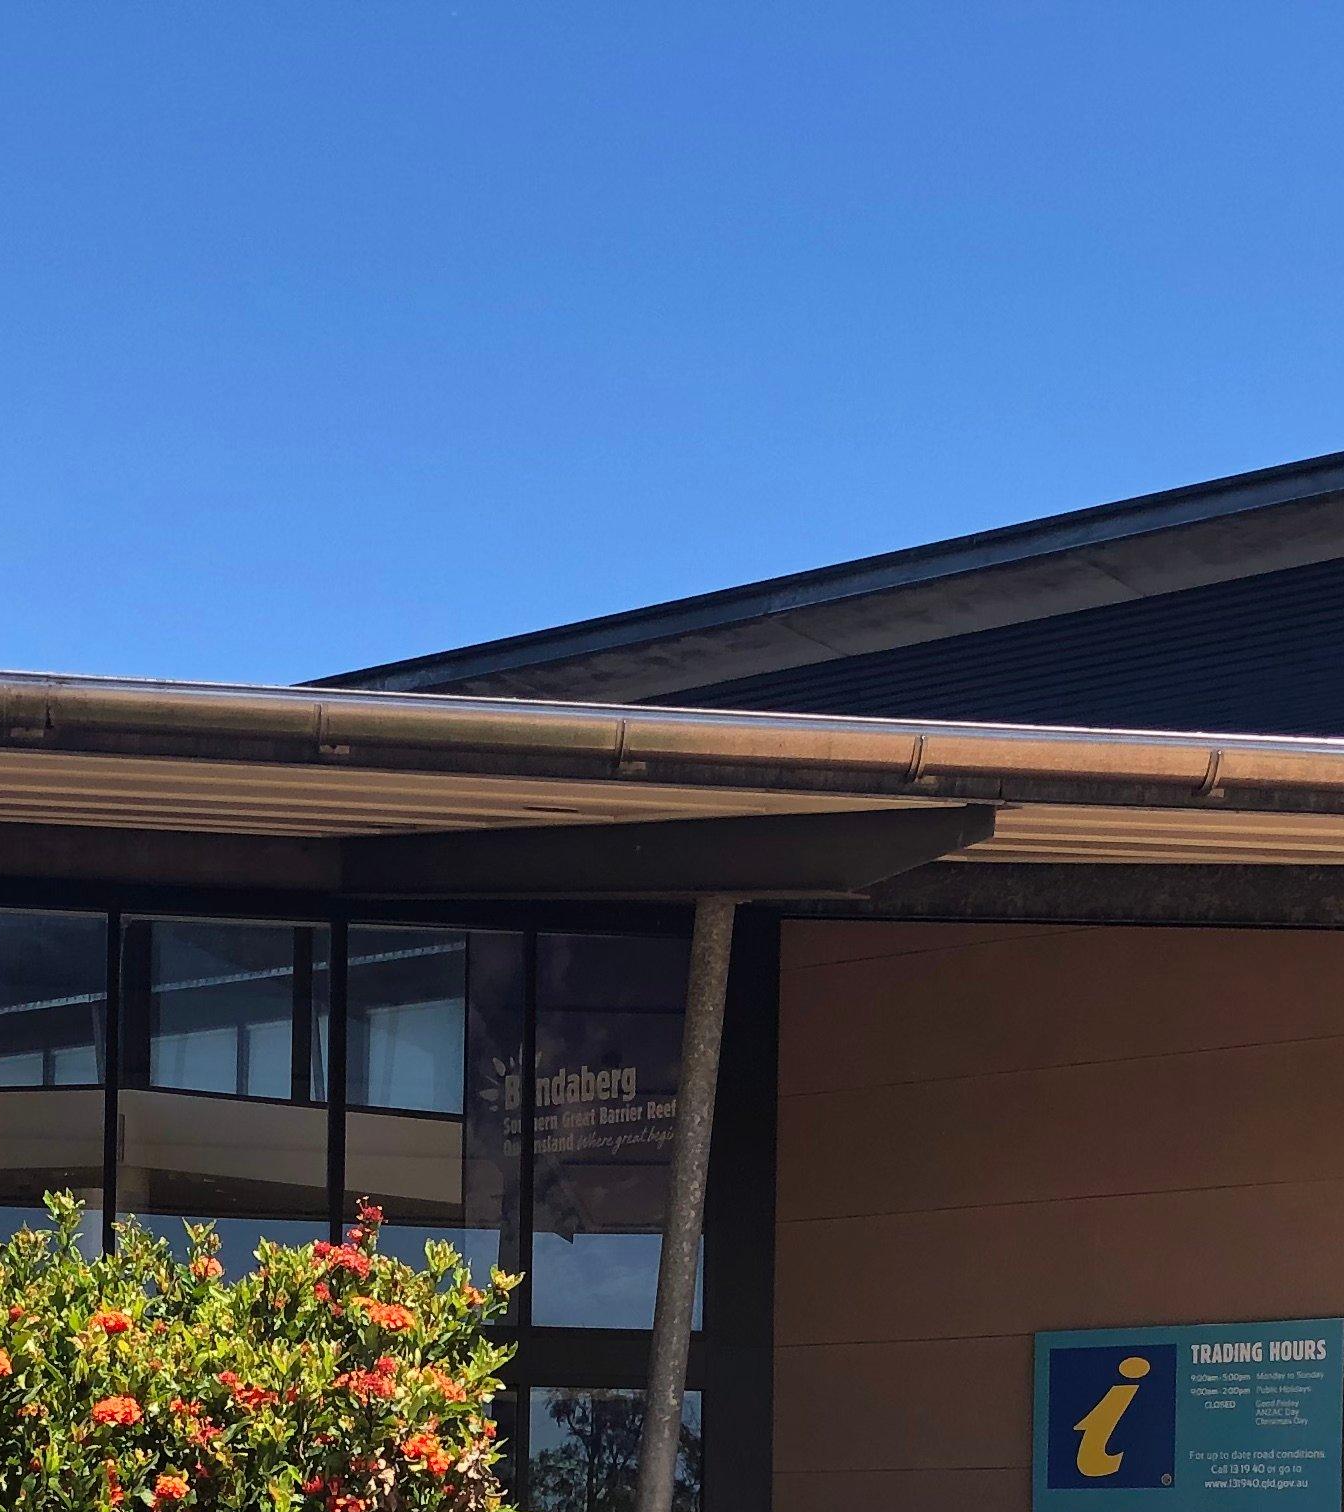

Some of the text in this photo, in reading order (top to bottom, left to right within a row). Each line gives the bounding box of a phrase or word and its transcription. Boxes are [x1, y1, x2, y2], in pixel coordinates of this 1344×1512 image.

[504, 1065, 637, 1110] Bndaberg
[1191, 1339, 1327, 1364] TRADING HOURS
[1231, 1450, 1251, 1460] date
[1253, 1450, 1274, 1460] road
[1276, 1448, 1325, 1460] conditions
[1211, 1464, 1228, 1474] Call
